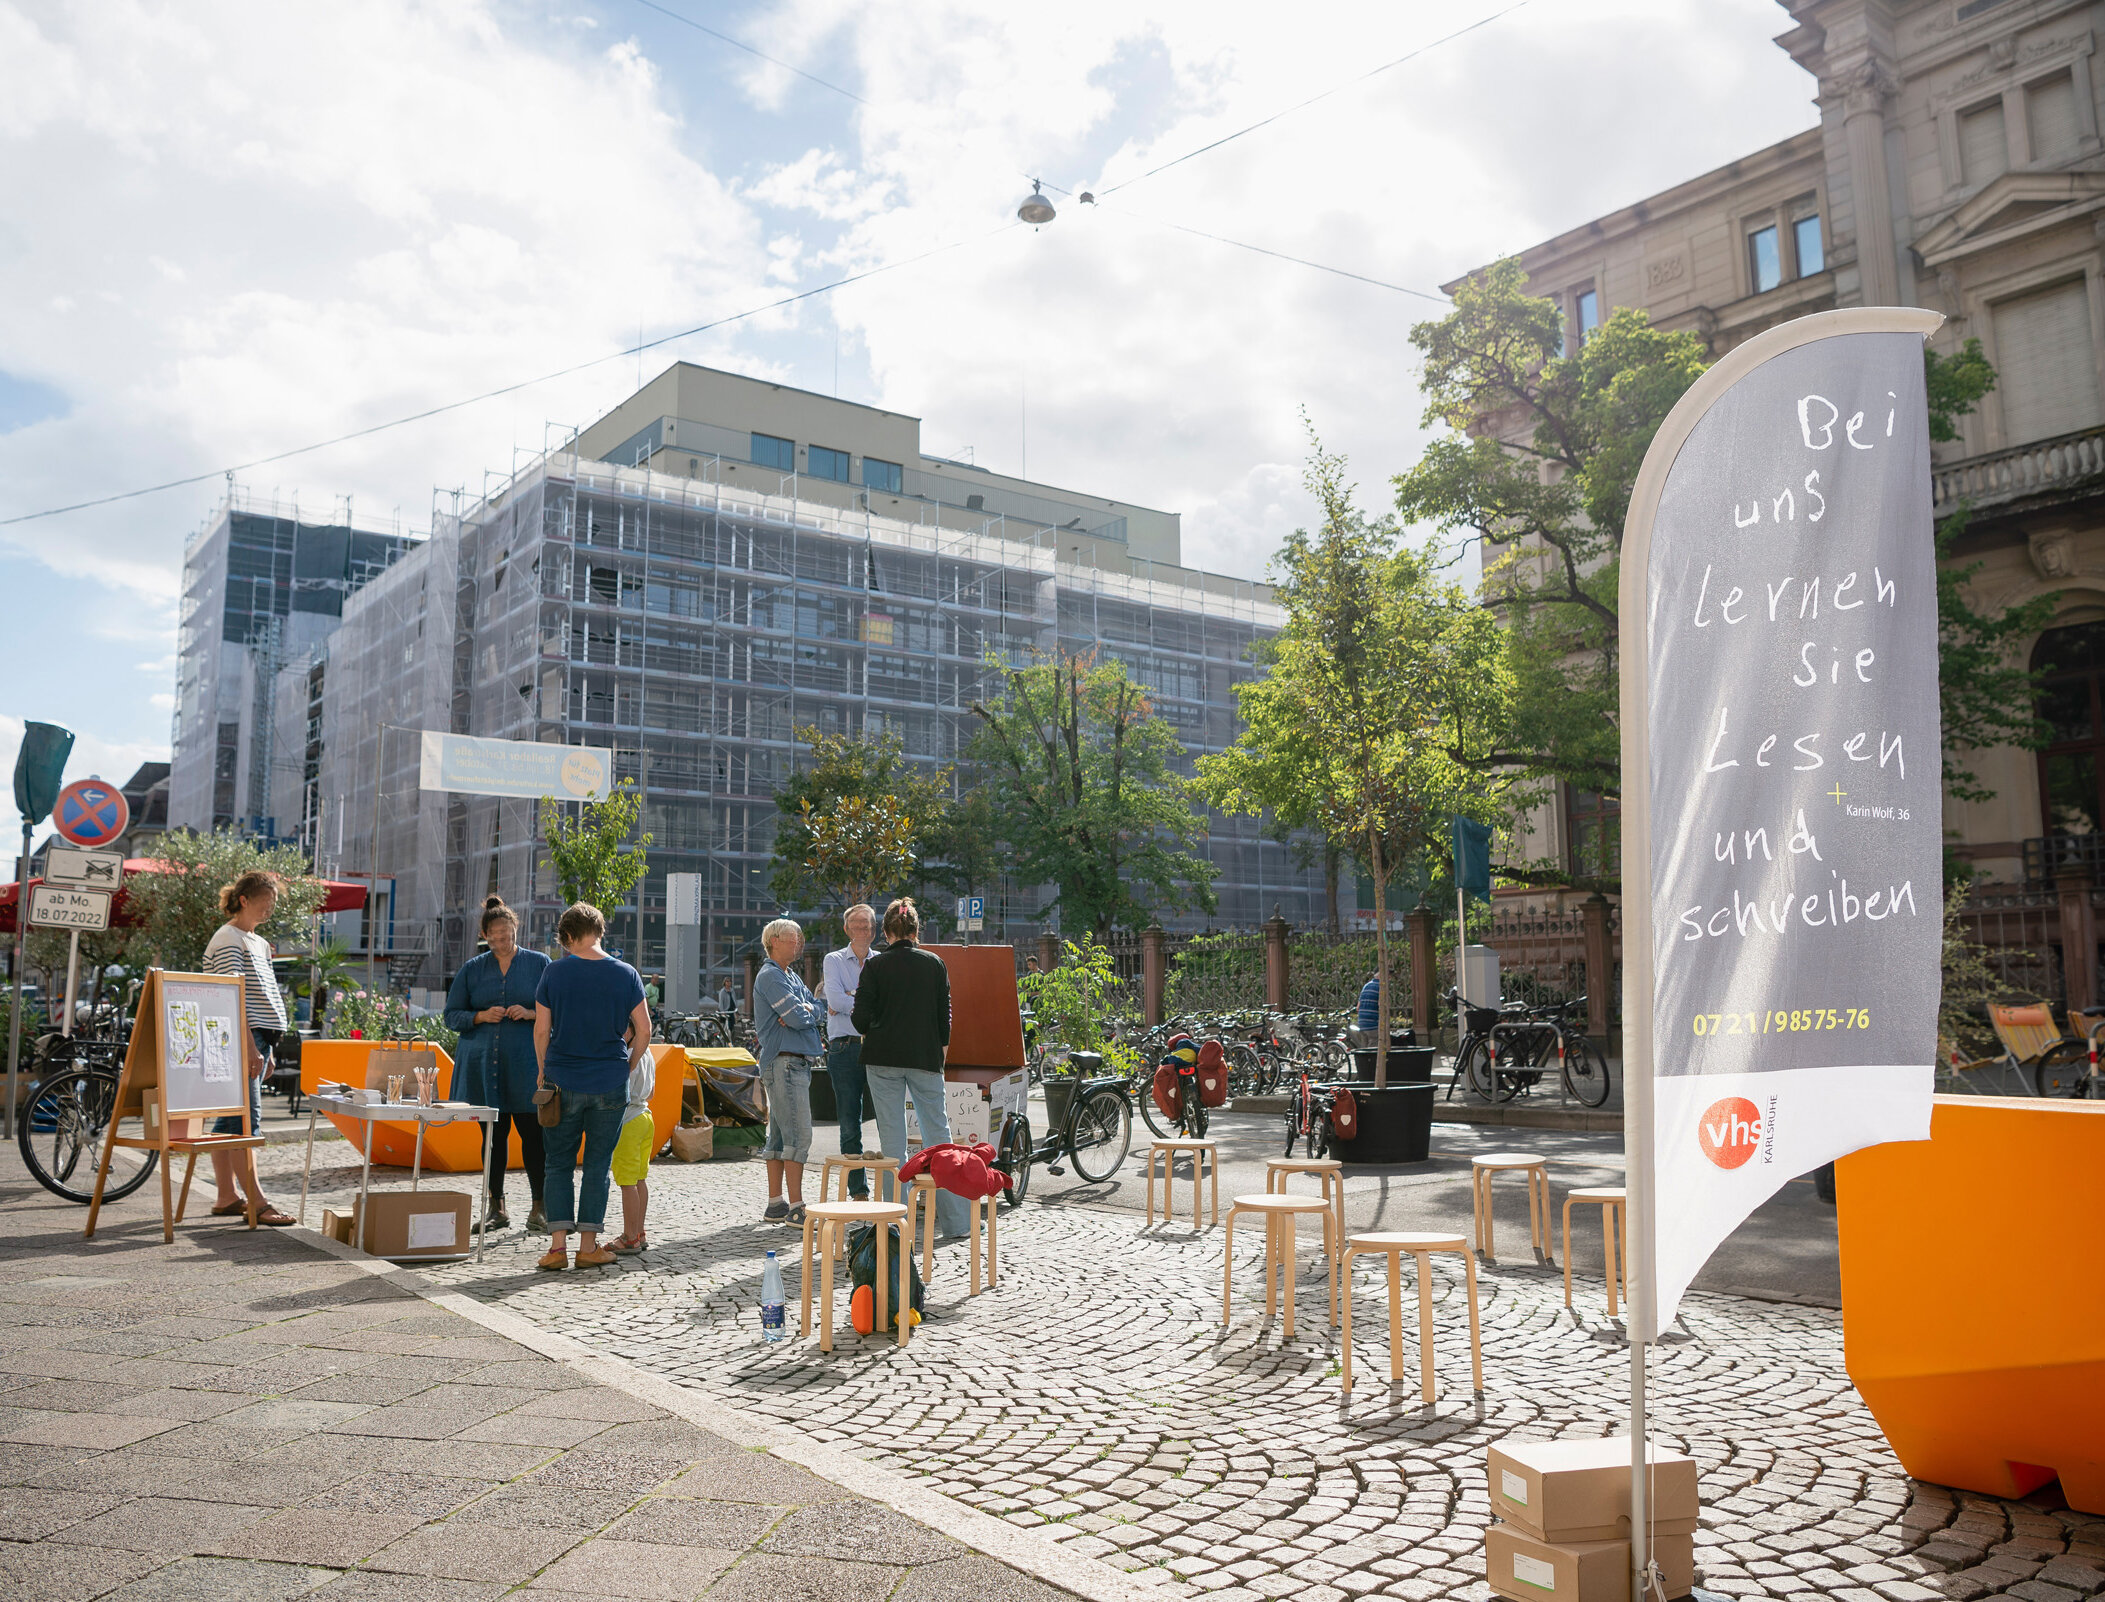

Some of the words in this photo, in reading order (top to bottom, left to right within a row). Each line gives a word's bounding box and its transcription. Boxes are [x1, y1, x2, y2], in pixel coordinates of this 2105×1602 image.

[1797, 391, 1896, 450] Bei
[1735, 469, 1825, 528] uns
[1693, 564, 1895, 628] lernen
[1793, 641, 1875, 687] Sie
[1705, 707, 1905, 780] Lesen
[1715, 809, 1823, 865] und
[1846, 804, 1870, 817] Karin
[1872, 806, 1896, 821] Wolf,
[1897, 808, 1910, 820] 36
[36, 908, 102, 925] 18.07.2022
[49, 893, 65, 905] ab
[70, 895, 92, 908] Mo.
[971, 900, 981, 917] P
[1680, 870, 1916, 941] schreiben
[958, 1103, 980, 1116] Sie
[1706, 1113, 1763, 1148] vhs
[1764, 1094, 1778, 1164] KARLSRUHE
